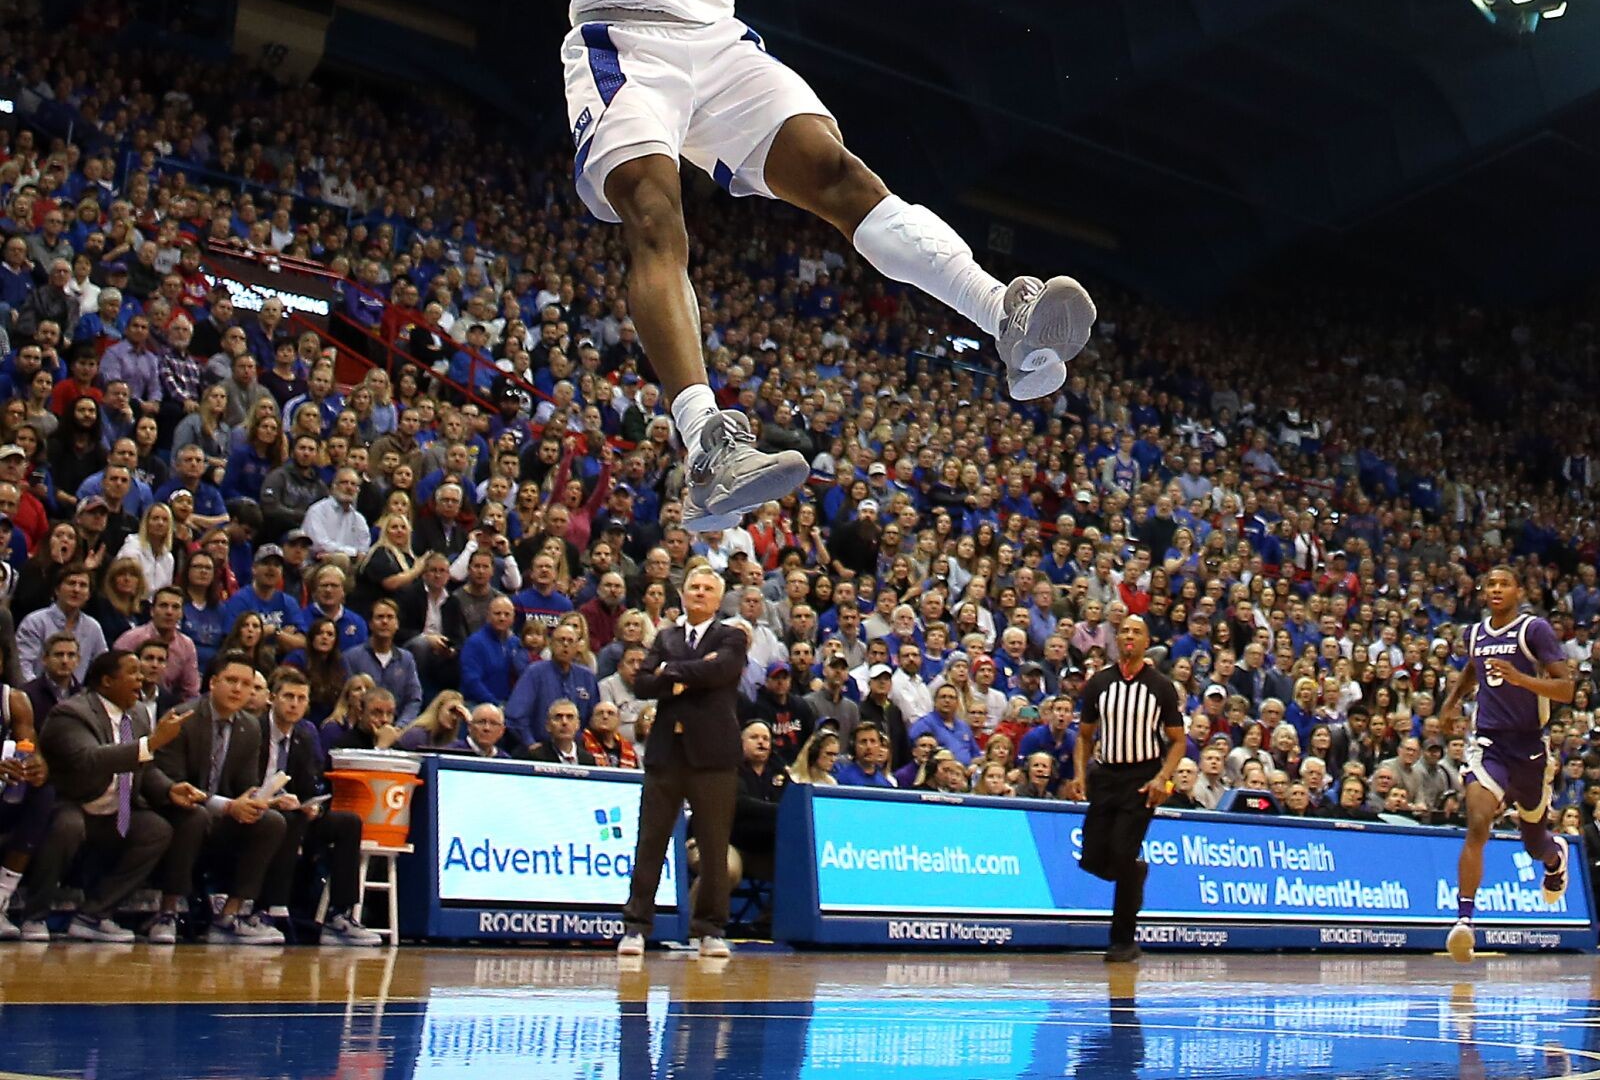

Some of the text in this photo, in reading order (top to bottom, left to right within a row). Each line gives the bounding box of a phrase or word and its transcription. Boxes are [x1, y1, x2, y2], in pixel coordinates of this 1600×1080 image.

[1475, 644, 1517, 657] K-STATE
[384, 785, 406, 810] G
[821, 840, 1020, 876] AdventHealth.com
[1181, 834, 1263, 869] Mission
[1268, 840, 1336, 872] Health
[1199, 875, 1410, 909] is now AdventHealth
[480, 912, 625, 939] ROCKET Mortga
[888, 921, 1012, 944] ROCKET Mortgage
[1176, 927, 1228, 946] Mortgage
[1320, 928, 1407, 946] ROCKET Mortgage
